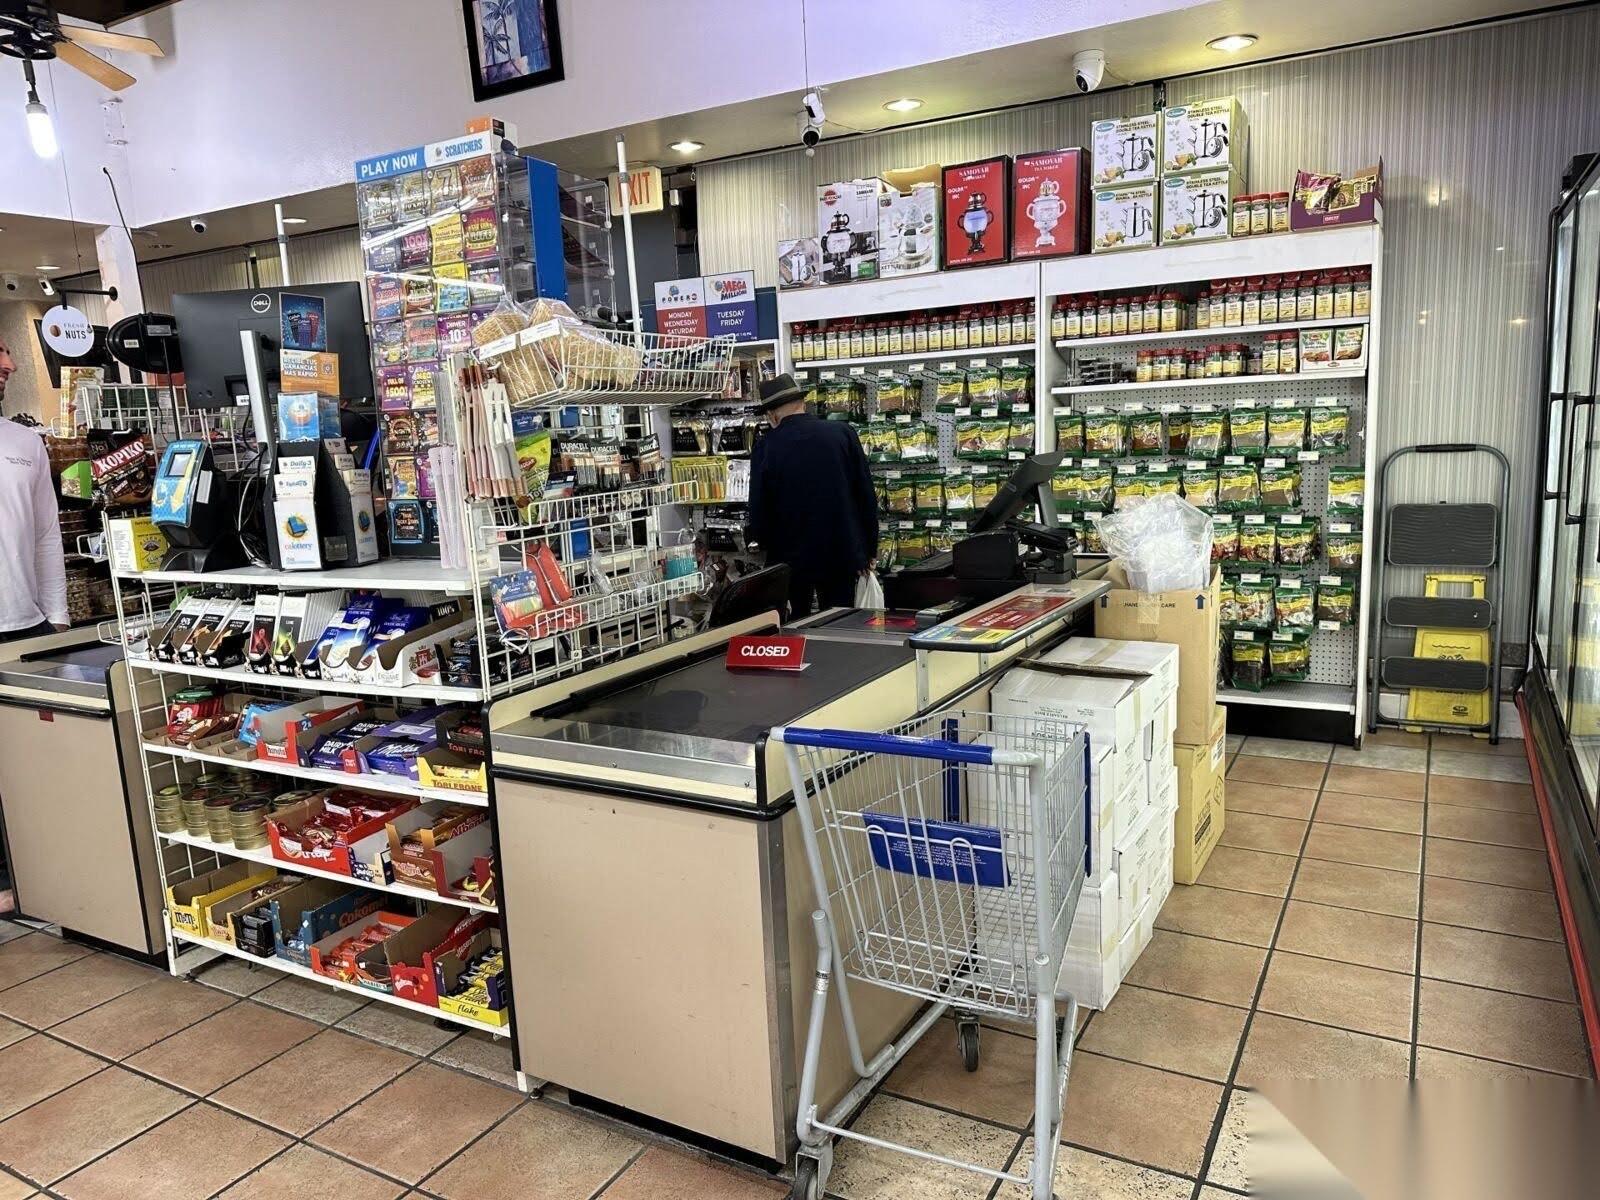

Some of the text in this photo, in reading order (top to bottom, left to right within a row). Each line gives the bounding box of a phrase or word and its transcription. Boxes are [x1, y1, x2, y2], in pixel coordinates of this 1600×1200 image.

[445, 138, 483, 157] SCRATCHERS
[361, 152, 418, 178] PLAY NOW
[1030, 157, 1063, 167] SAMOVAR
[959, 167, 990, 176] SAMOVAR
[617, 172, 650, 207] XIT
[721, 281, 748, 293] MEGA
[668, 311, 692, 319] MONDAY
[717, 310, 745, 318] TUESDAY
[664, 319, 699, 328] WEDNESDAY
[720, 318, 743, 327] FRIDAY
[65, 330, 87, 339] NUTS
[667, 327, 697, 335] SATURDAY
[560, 441, 588, 450] DURACELL
[591, 445, 619, 454] DURACELL
[97, 440, 145, 473] KOPIKO
[437, 605, 455, 616] 100%
[741, 645, 789, 656] CLOSED
[324, 740, 345, 748] DAIRY
[319, 746, 336, 754] MILK
[432, 779, 482, 793] TOBLERONE
[457, 1003, 480, 1017] flake
